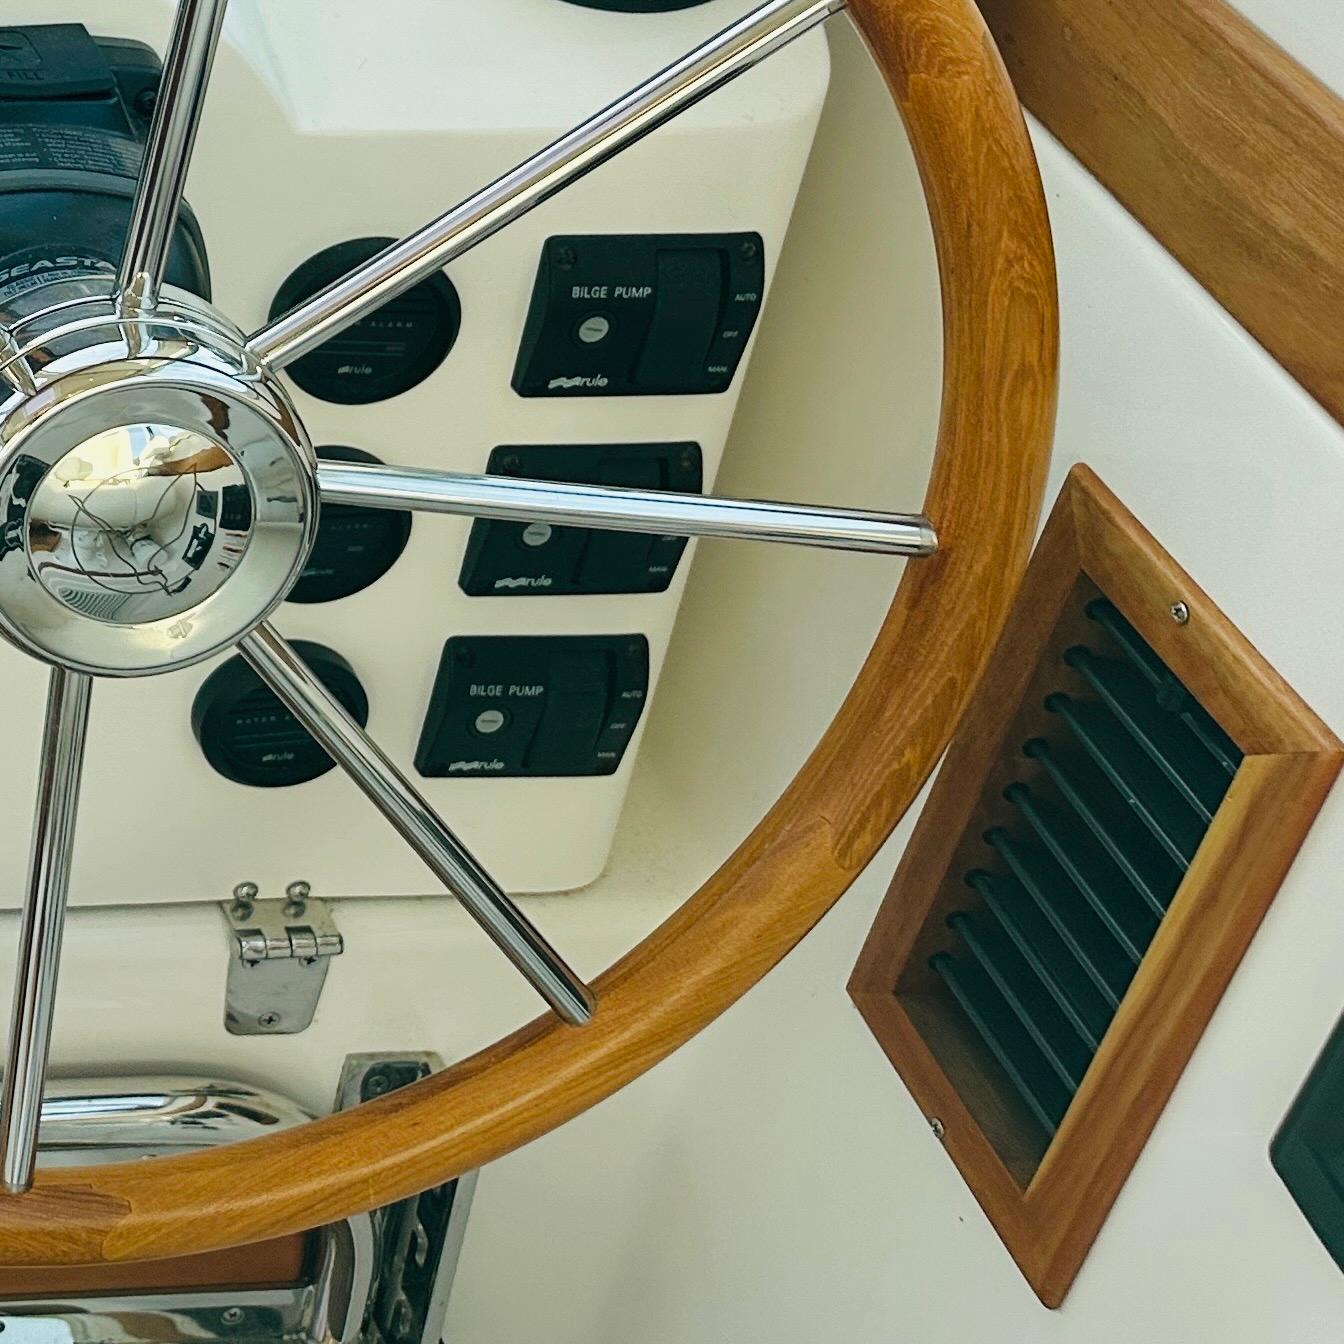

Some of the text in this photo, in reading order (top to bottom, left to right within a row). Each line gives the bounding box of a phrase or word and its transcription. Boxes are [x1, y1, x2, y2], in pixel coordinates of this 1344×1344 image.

[571, 285, 652, 299] BILGE PUMP
[735, 292, 757, 302] AUTO
[469, 684, 545, 697] BILGE PUMP
